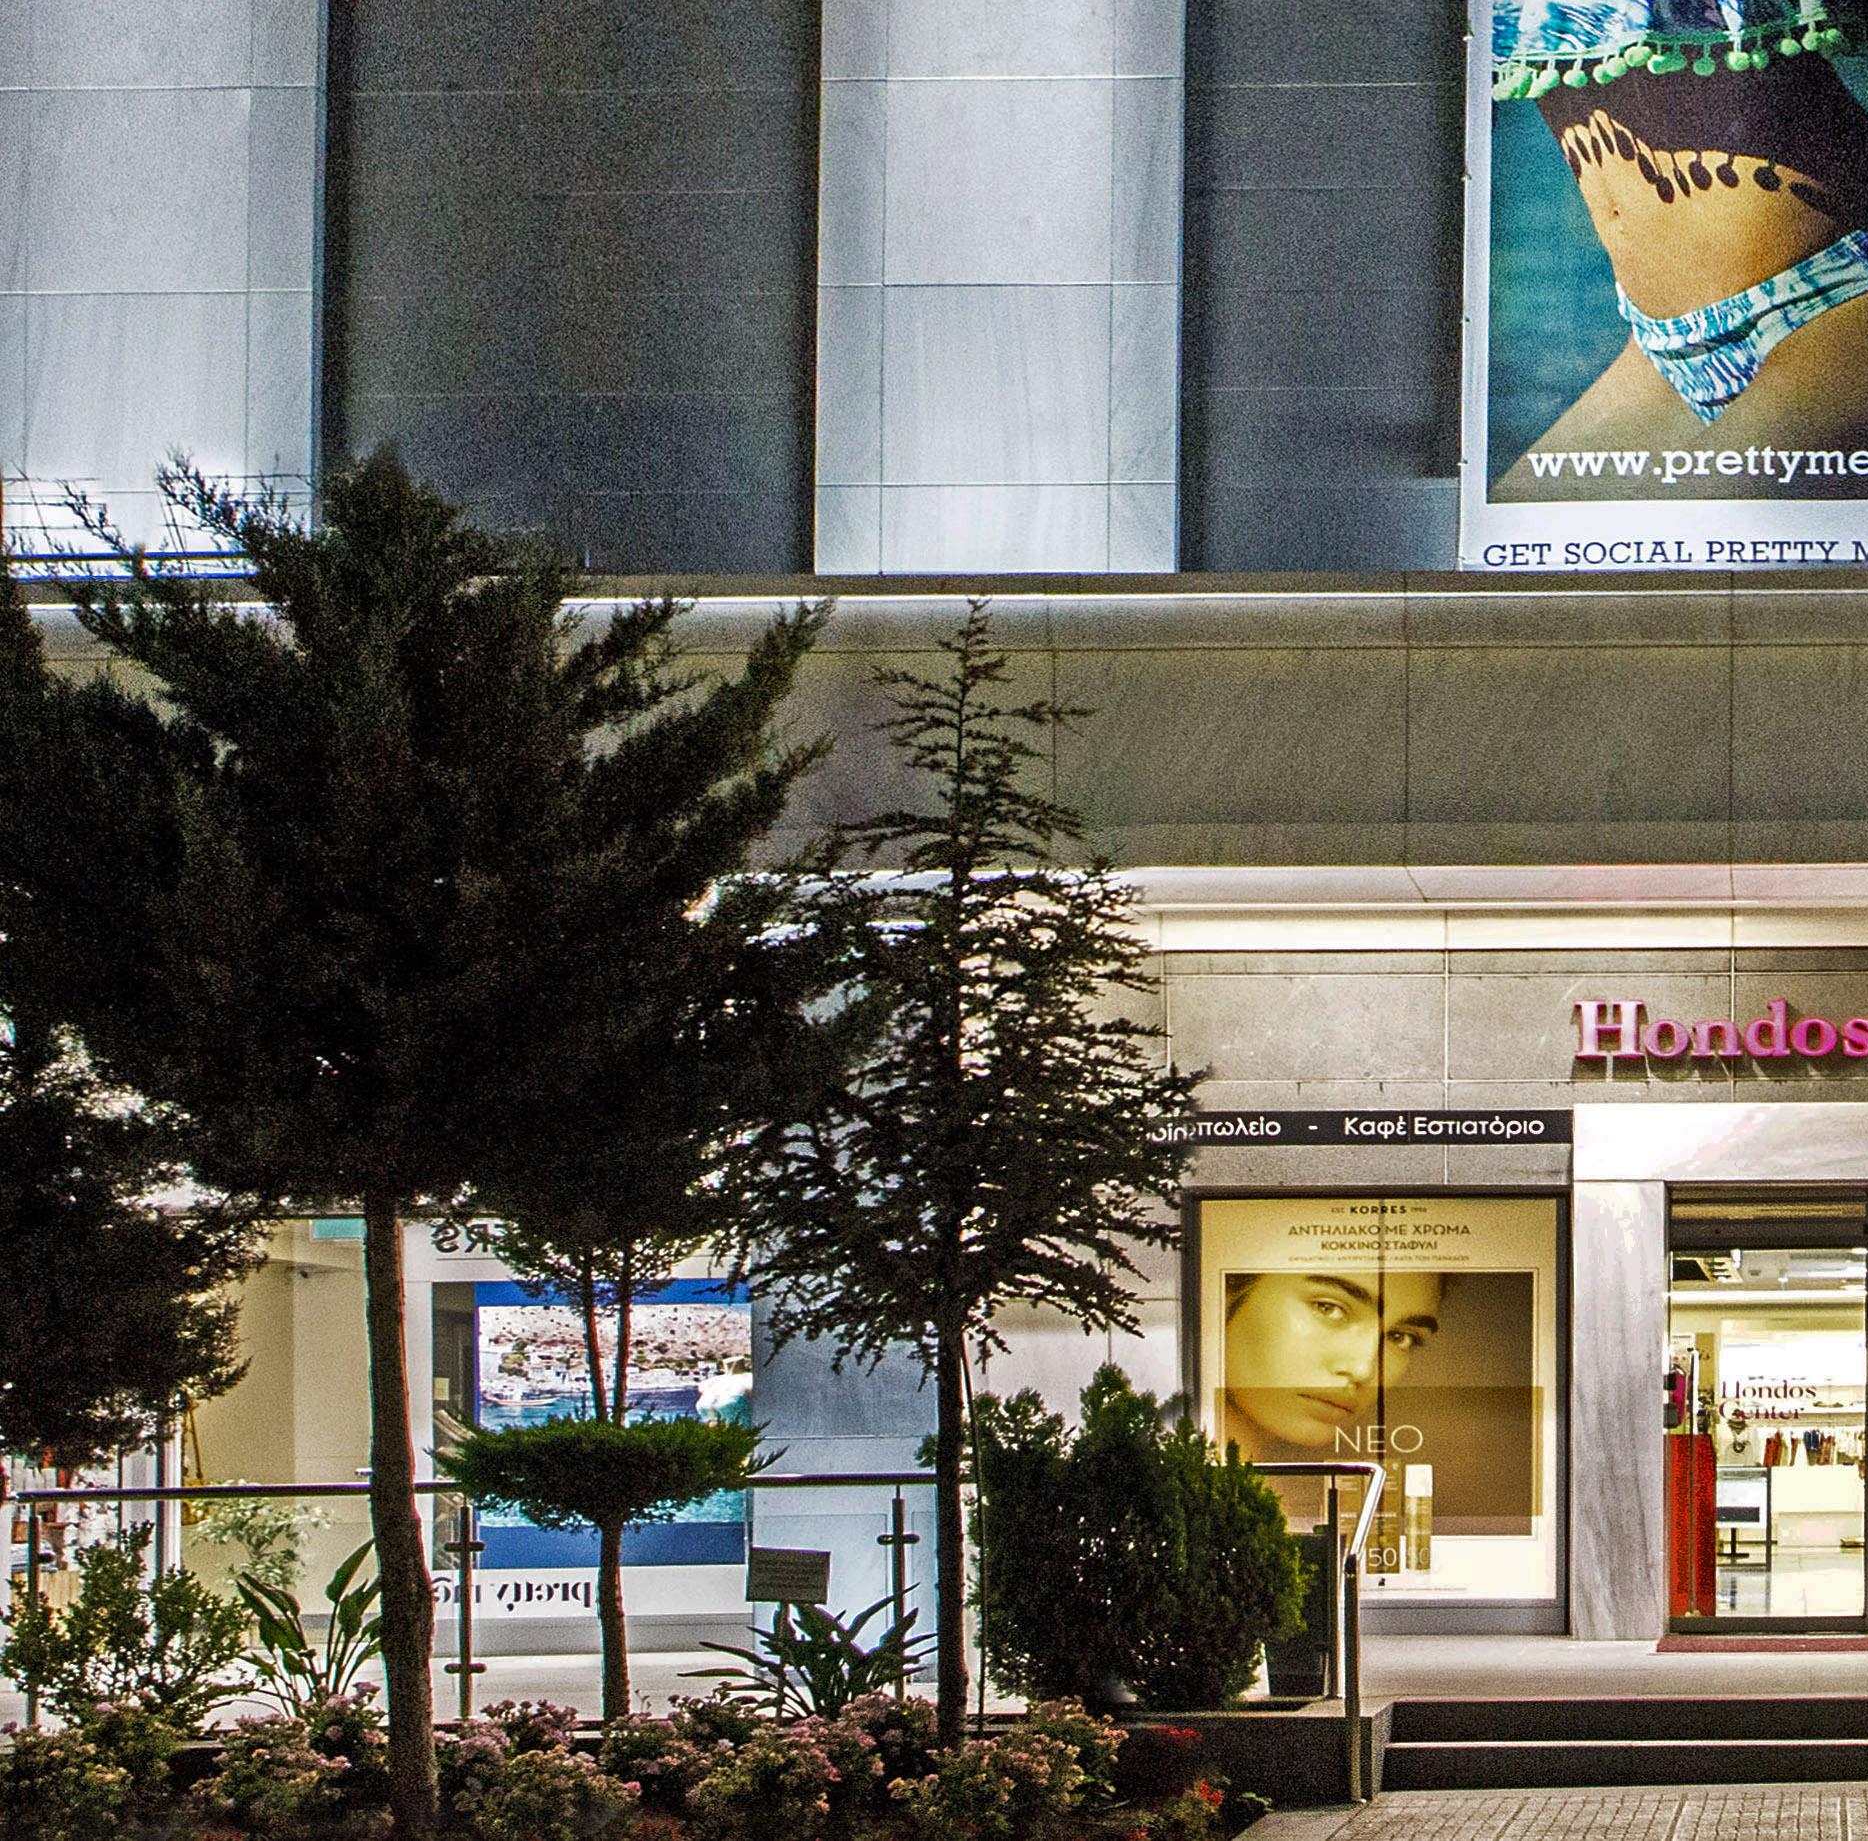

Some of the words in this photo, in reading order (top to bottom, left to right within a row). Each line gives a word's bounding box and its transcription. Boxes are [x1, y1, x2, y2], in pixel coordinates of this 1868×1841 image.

[1483, 542, 1552, 568] GET
[1563, 540, 1692, 566] SOCIAL
[1706, 539, 1838, 564] PRETTY
[1344, 1115, 1407, 1141] Καφέ
[1414, 1116, 1545, 1139] Εστιατόριο
[1349, 1205, 1408, 1215] KORRES
[1334, 1424, 1425, 1454] NEO
[1368, 1547, 1397, 1568] 50
